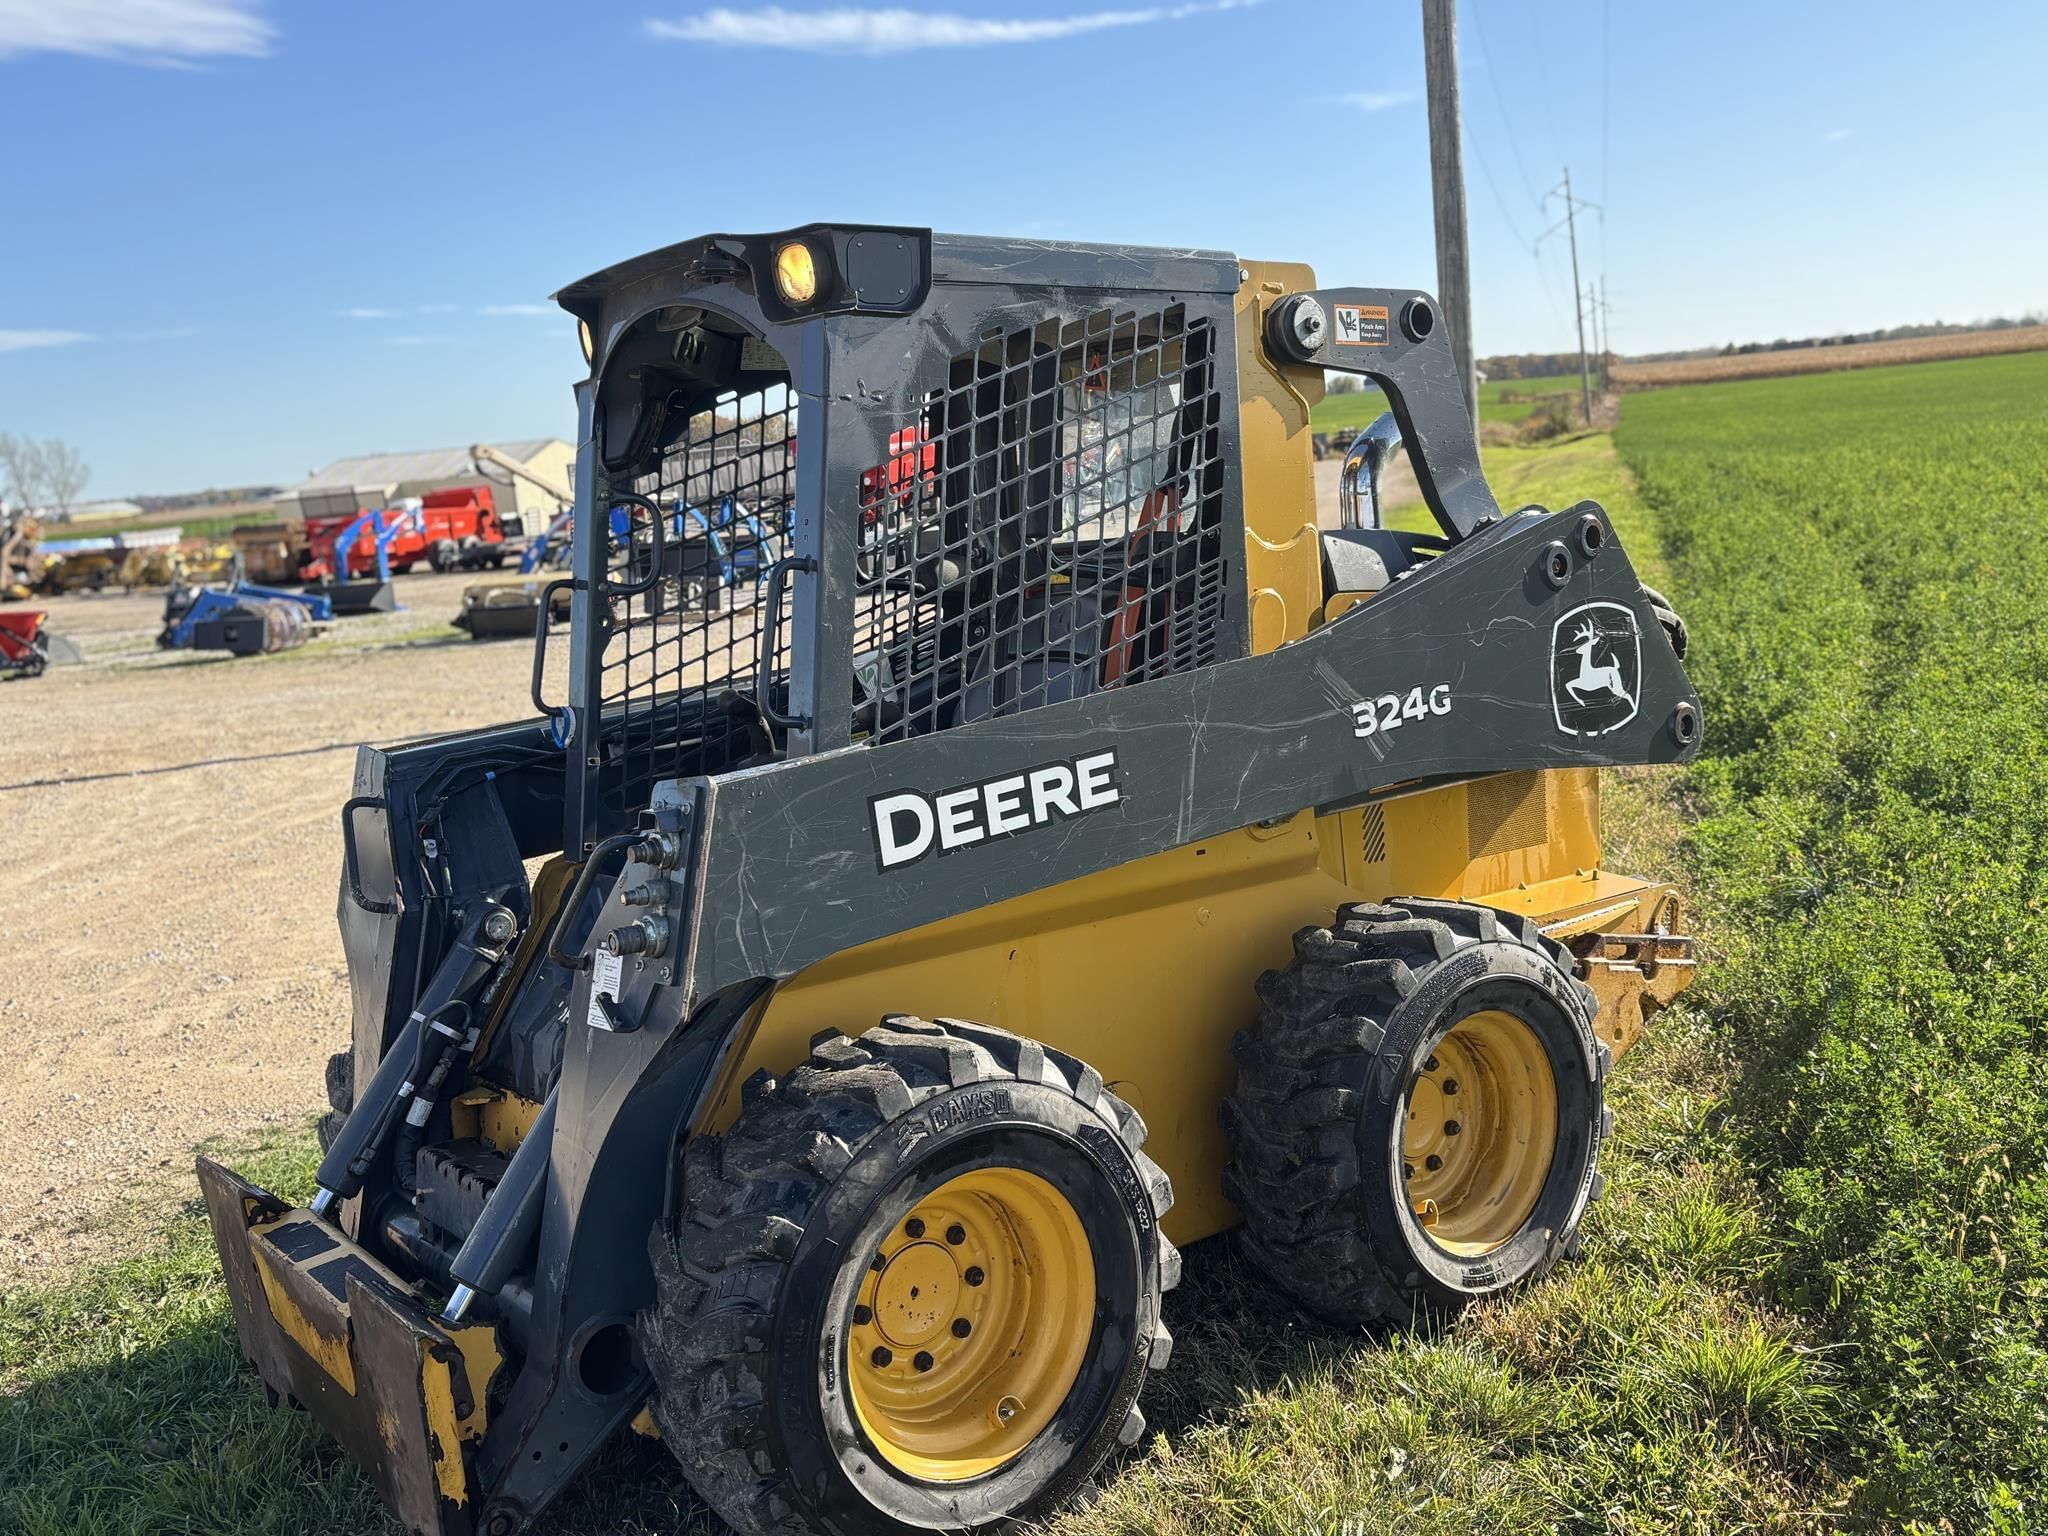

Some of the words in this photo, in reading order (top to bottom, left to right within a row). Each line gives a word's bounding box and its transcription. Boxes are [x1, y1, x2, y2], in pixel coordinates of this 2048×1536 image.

[1352, 684, 1452, 737] 324G
[874, 752, 1119, 867] DEERE
[928, 1088, 1010, 1134] CAMSO
